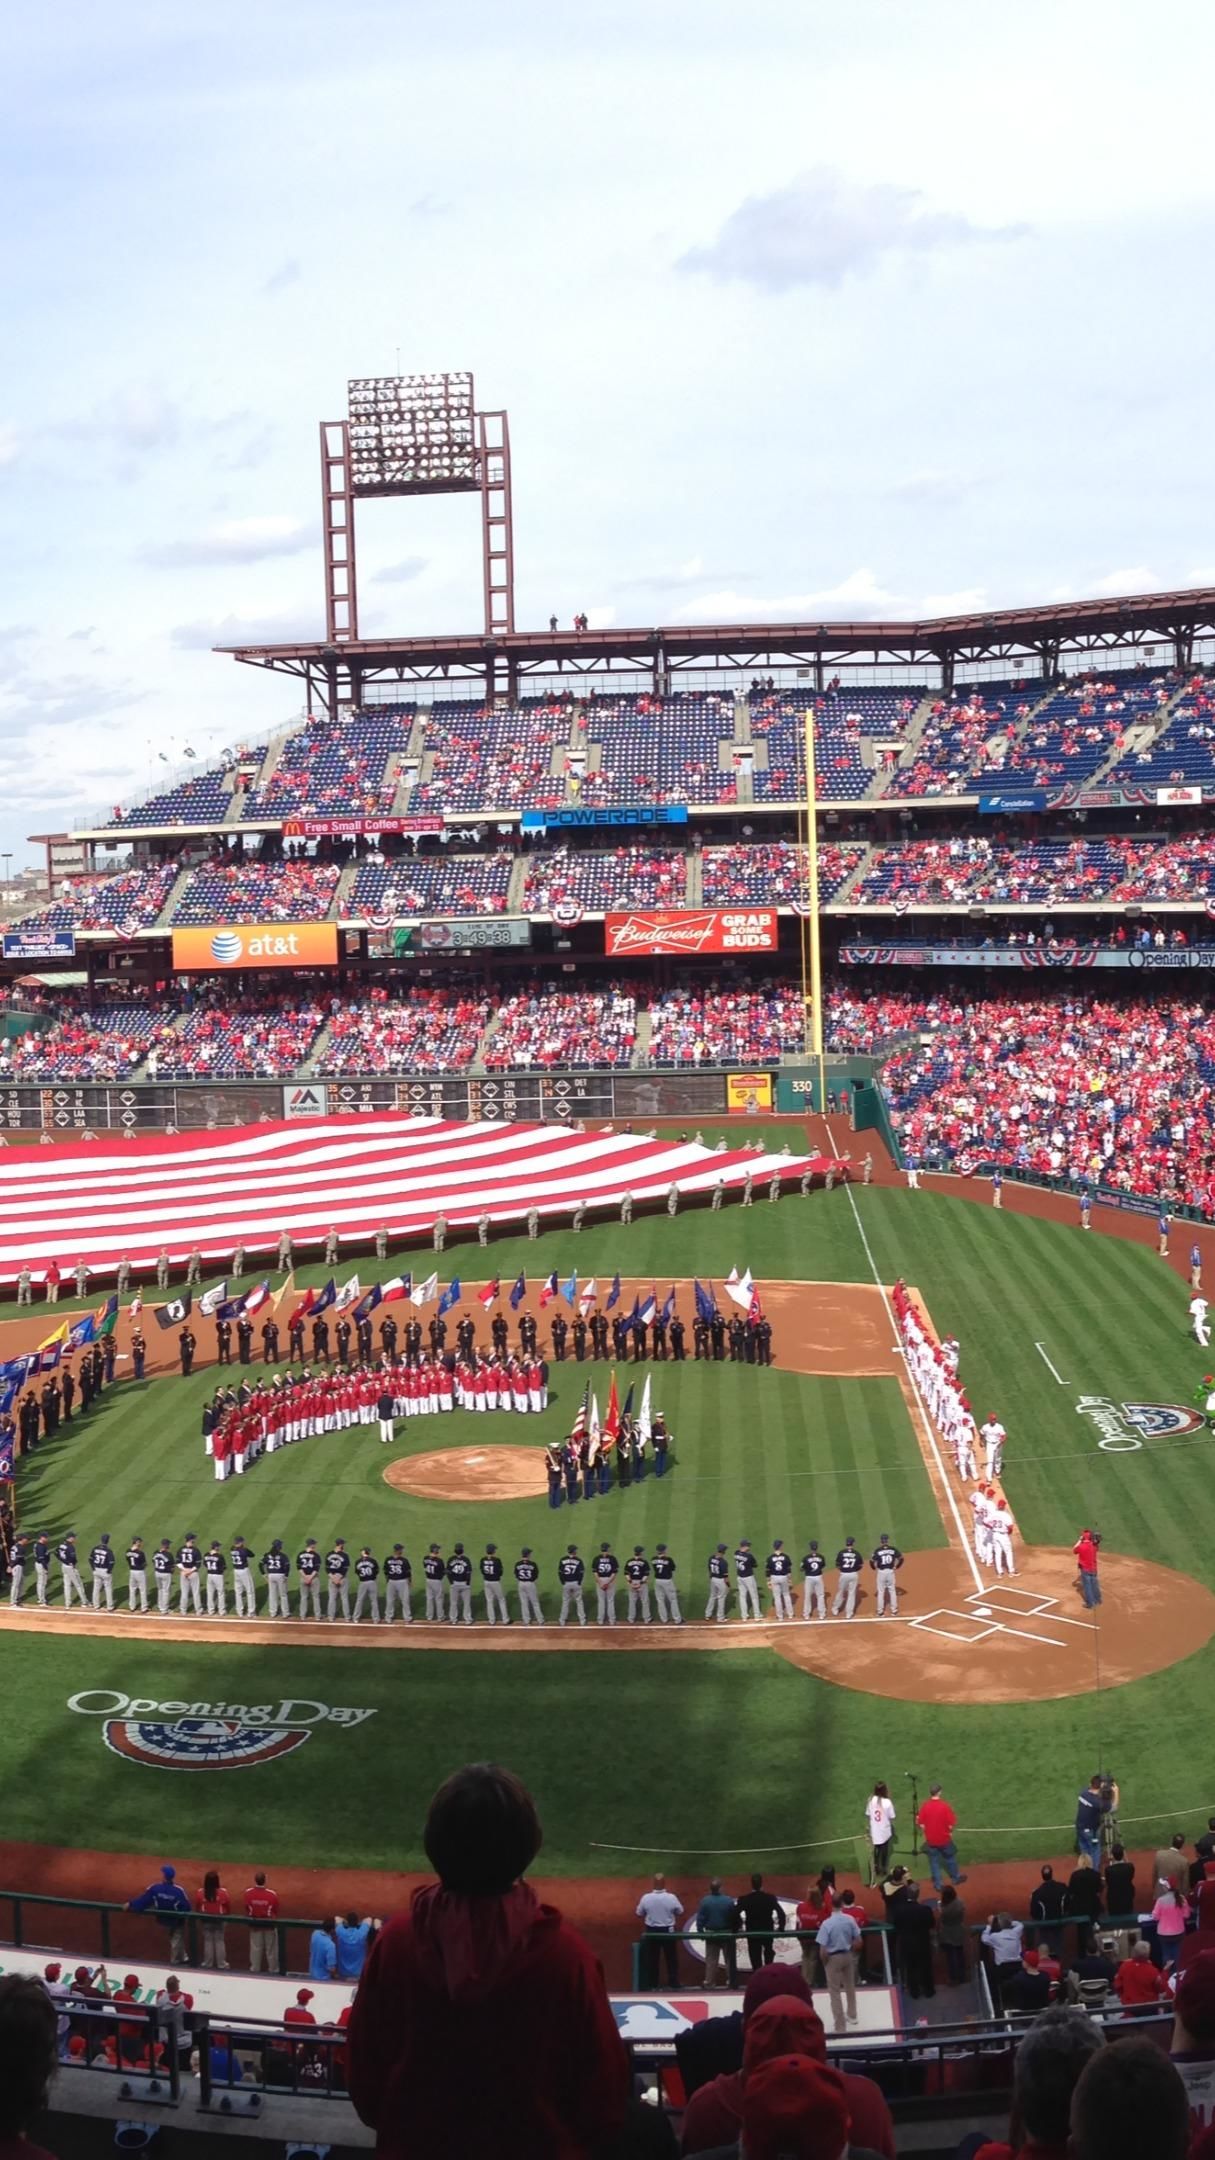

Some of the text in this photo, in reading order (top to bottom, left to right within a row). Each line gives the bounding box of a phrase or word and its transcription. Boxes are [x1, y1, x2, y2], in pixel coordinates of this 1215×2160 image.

[305, 818, 399, 833] Free Small Coffee
[721, 914, 772, 928] GRAB
[609, 925, 714, 943] Budweiser
[730, 926, 763, 936] SOME
[248, 932, 299, 956] at&t
[722, 933, 772, 947] BUDS
[1128, 950, 1187, 968] Opening
[791, 1080, 812, 1092] 330
[430, 1092, 443, 1101] ATL
[503, 1089, 516, 1098] STL
[577, 1088, 586, 1096] LA
[289, 1105, 320, 1113] Majestic
[503, 1101, 518, 1109] CWS
[74, 1119, 86, 1128] SEA
[93, 1554, 106, 1565] 37
[129, 1555, 136, 1567] 1
[154, 1558, 165, 1569] 12
[181, 1553, 193, 1563] 13
[301, 1558, 314, 1569] 24
[842, 1558, 857, 1569] 27
[206, 1560, 217, 1570] 14
[267, 1559, 281, 1569] 23
[483, 1564, 495, 1575] 51
[564, 1564, 577, 1575] 57
[598, 1563, 612, 1573] 59
[656, 1564, 664, 1574] 7
[774, 1560, 783, 1571] 8
[810, 1562, 819, 1572] 9
[632, 1565, 640, 1576] 2
[67, 1690, 378, 1727] Opening Day
[874, 1810, 881, 1823] 3
